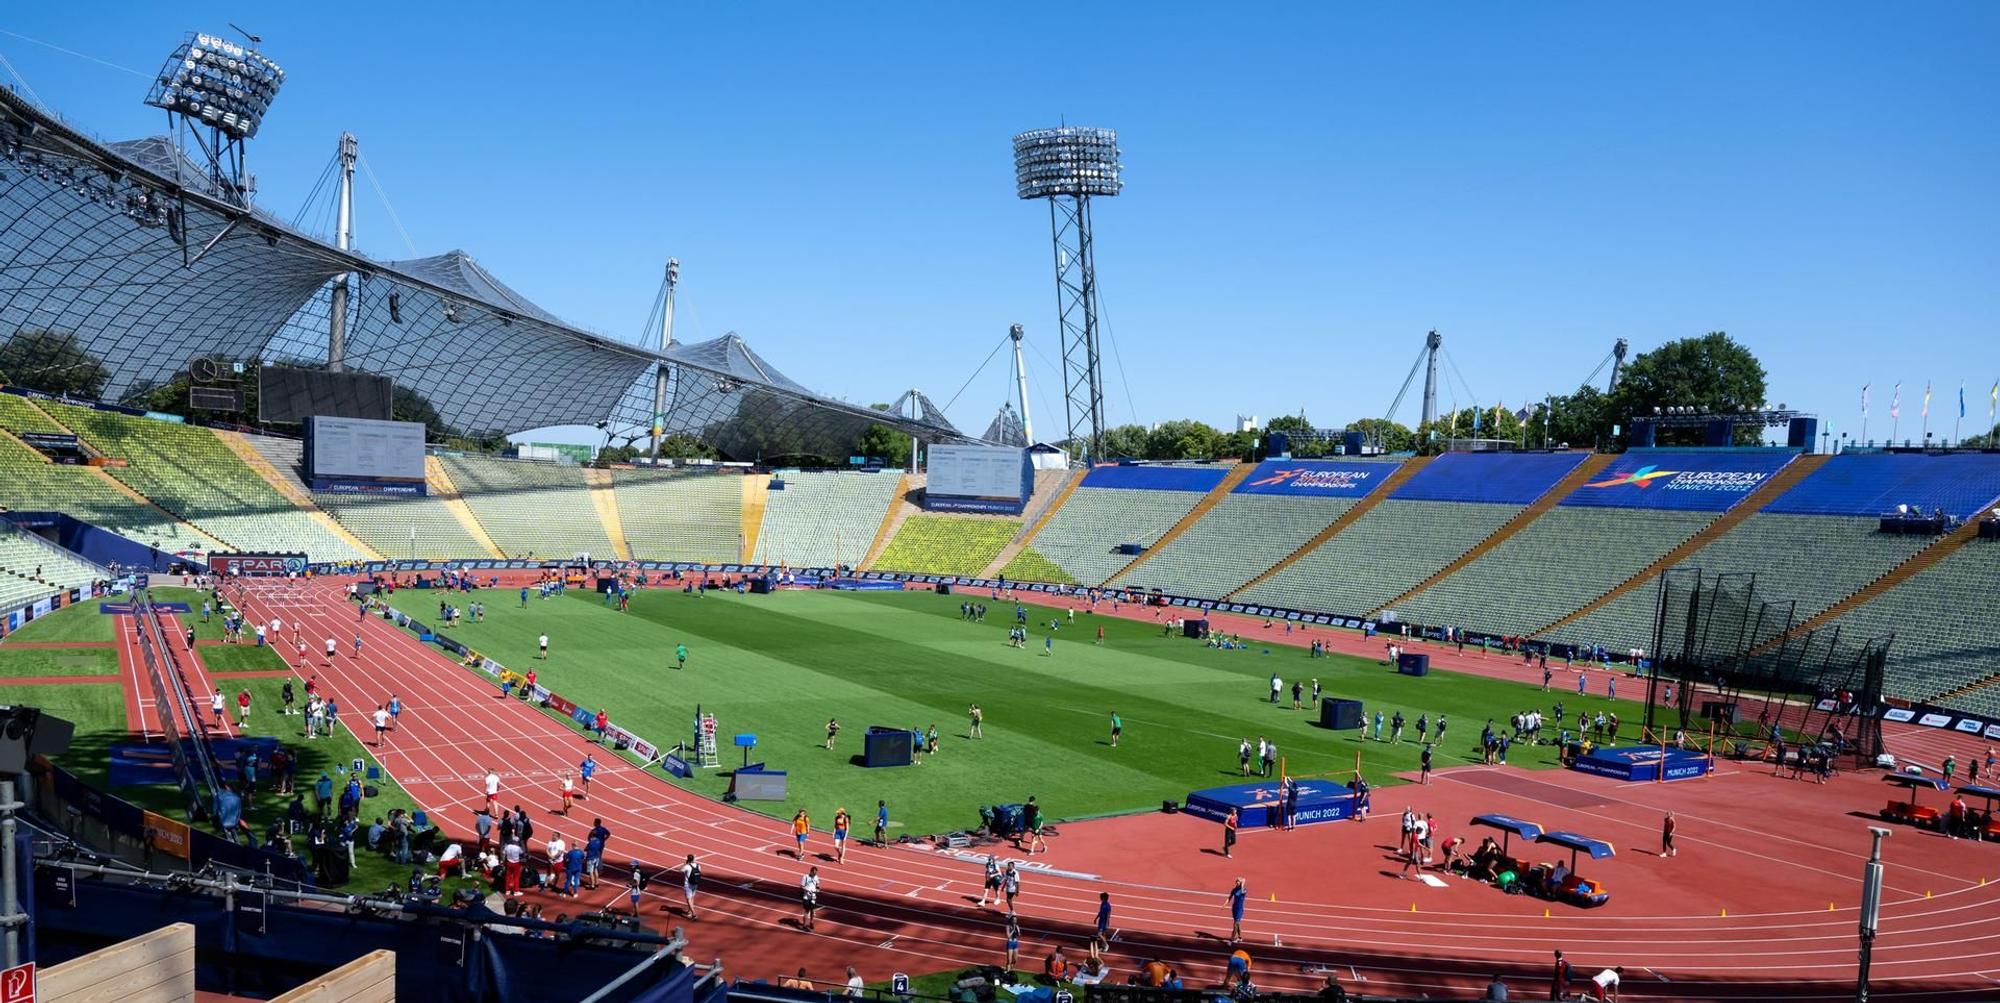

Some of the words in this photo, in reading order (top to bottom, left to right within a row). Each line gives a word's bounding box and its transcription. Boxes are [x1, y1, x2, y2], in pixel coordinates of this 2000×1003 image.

[1300, 470, 1370, 479] EUROPEAN
[1676, 471, 1767, 480] EUROPEAN
[333, 484, 359, 492] EUROPEAN
[228, 560, 283, 569] SPAR
[1667, 768, 1687, 777] MUNICH
[1687, 766, 1699, 775] 2022
[1323, 807, 1340, 818] 2022
[896, 981, 905, 991] 4
